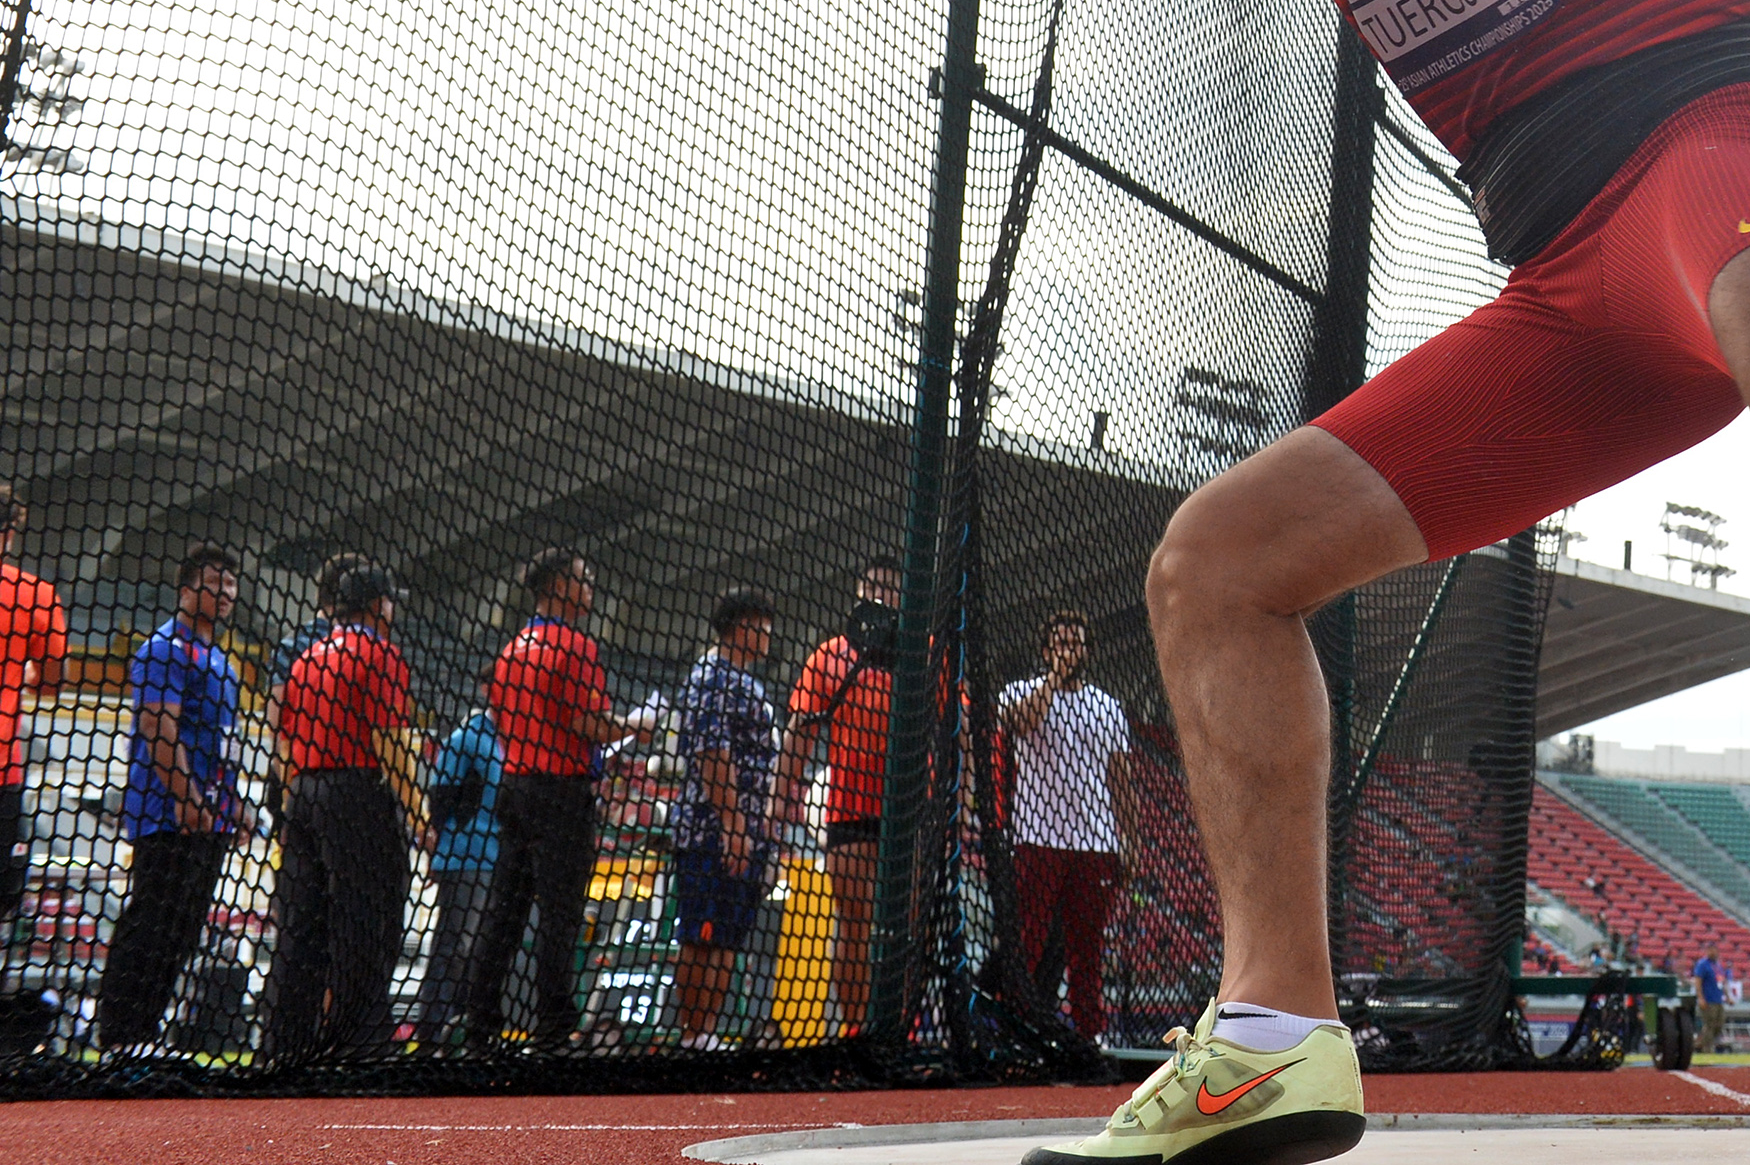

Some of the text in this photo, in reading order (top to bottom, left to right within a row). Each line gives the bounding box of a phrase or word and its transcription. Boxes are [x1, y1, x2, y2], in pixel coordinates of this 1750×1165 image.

[1406, 68, 1431, 88] ASIAN
[1428, 45, 1472, 77] ATHLETICS
[1469, 11, 1531, 55] CHAMPIONSHIPS
